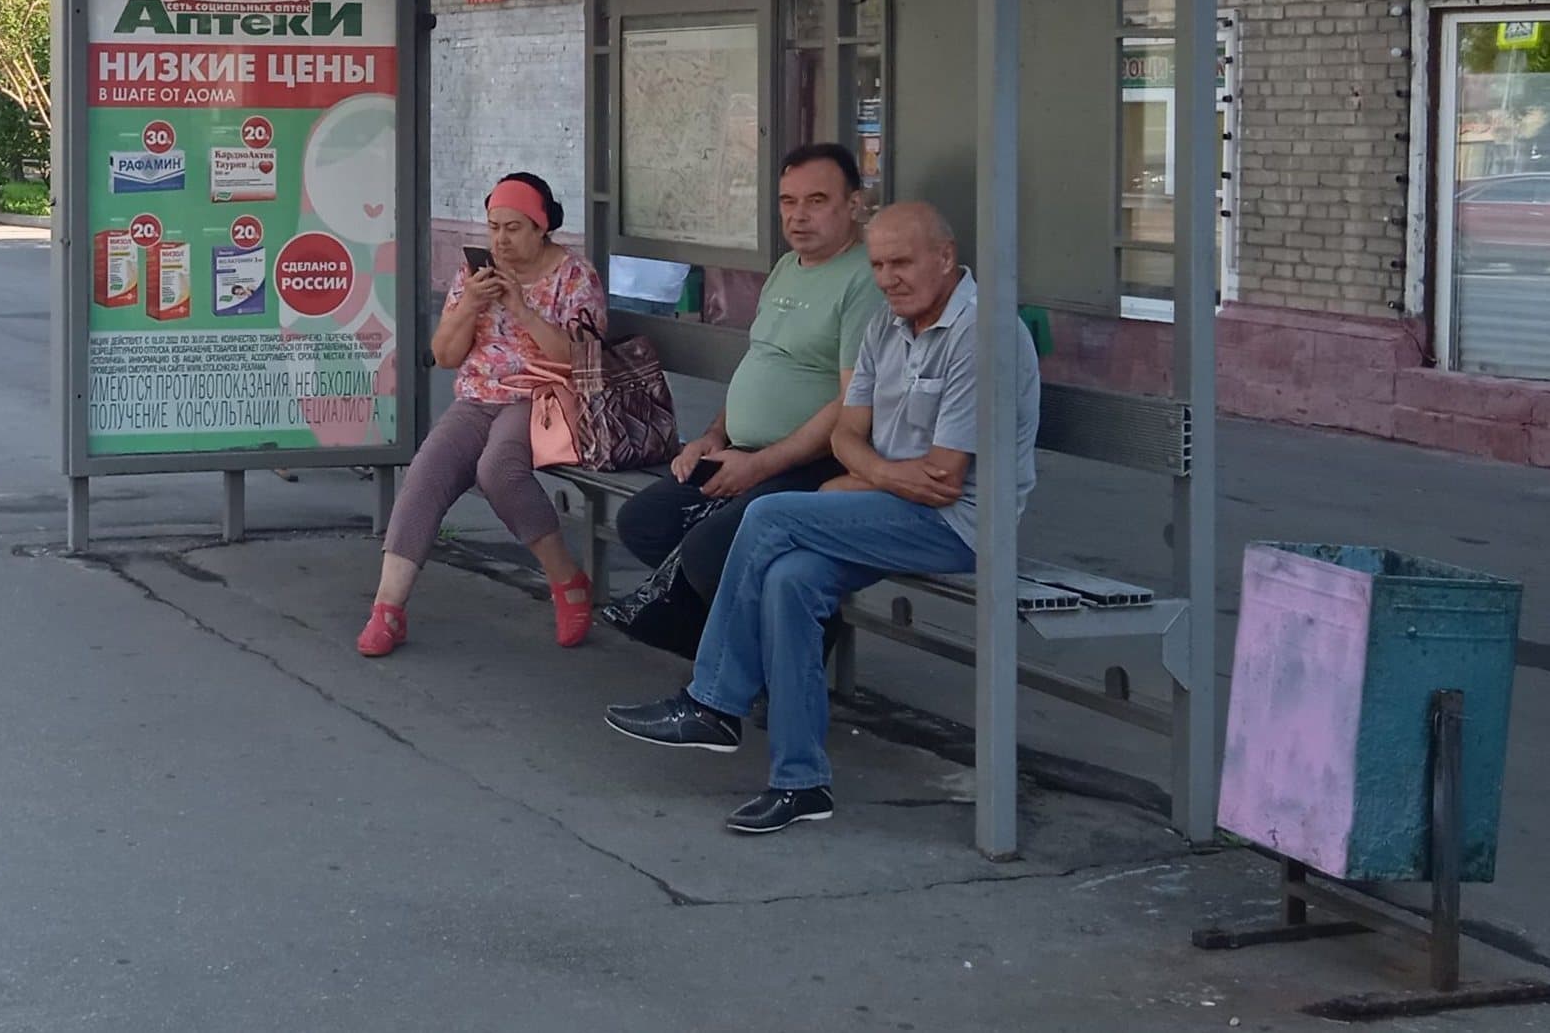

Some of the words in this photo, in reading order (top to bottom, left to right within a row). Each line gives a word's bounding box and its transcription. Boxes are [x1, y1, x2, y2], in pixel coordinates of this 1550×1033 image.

[195, 2, 271, 13] социальных
[274, 4, 310, 13] аптек
[100, 52, 256, 83] НИЗКИЕ
[267, 54, 375, 88] ЦЕНЫ
[99, 88, 108, 101] В
[113, 88, 156, 102] ШАГЕ
[160, 88, 179, 102] ОТ
[184, 88, 236, 104] ДОМА
[118, 158, 182, 172] РАФАМИН
[281, 261, 337, 273] СДЕЛАНО
[340, 262, 347, 271] В
[281, 277, 347, 291] РОССИИ
[90, 374, 152, 402] ИМЕЮТСЯ
[156, 372, 292, 400] ПРОТИВОПОКАЗАНИЯ.
[295, 370, 379, 397] НЕОБХОДИМО
[90, 402, 169, 431] ПОЛУЧЕНИЕ
[176, 399, 280, 428] КОНСУЛЬТАЦИИ
[288, 397, 380, 425] СПЕЦИАЛИСТА
